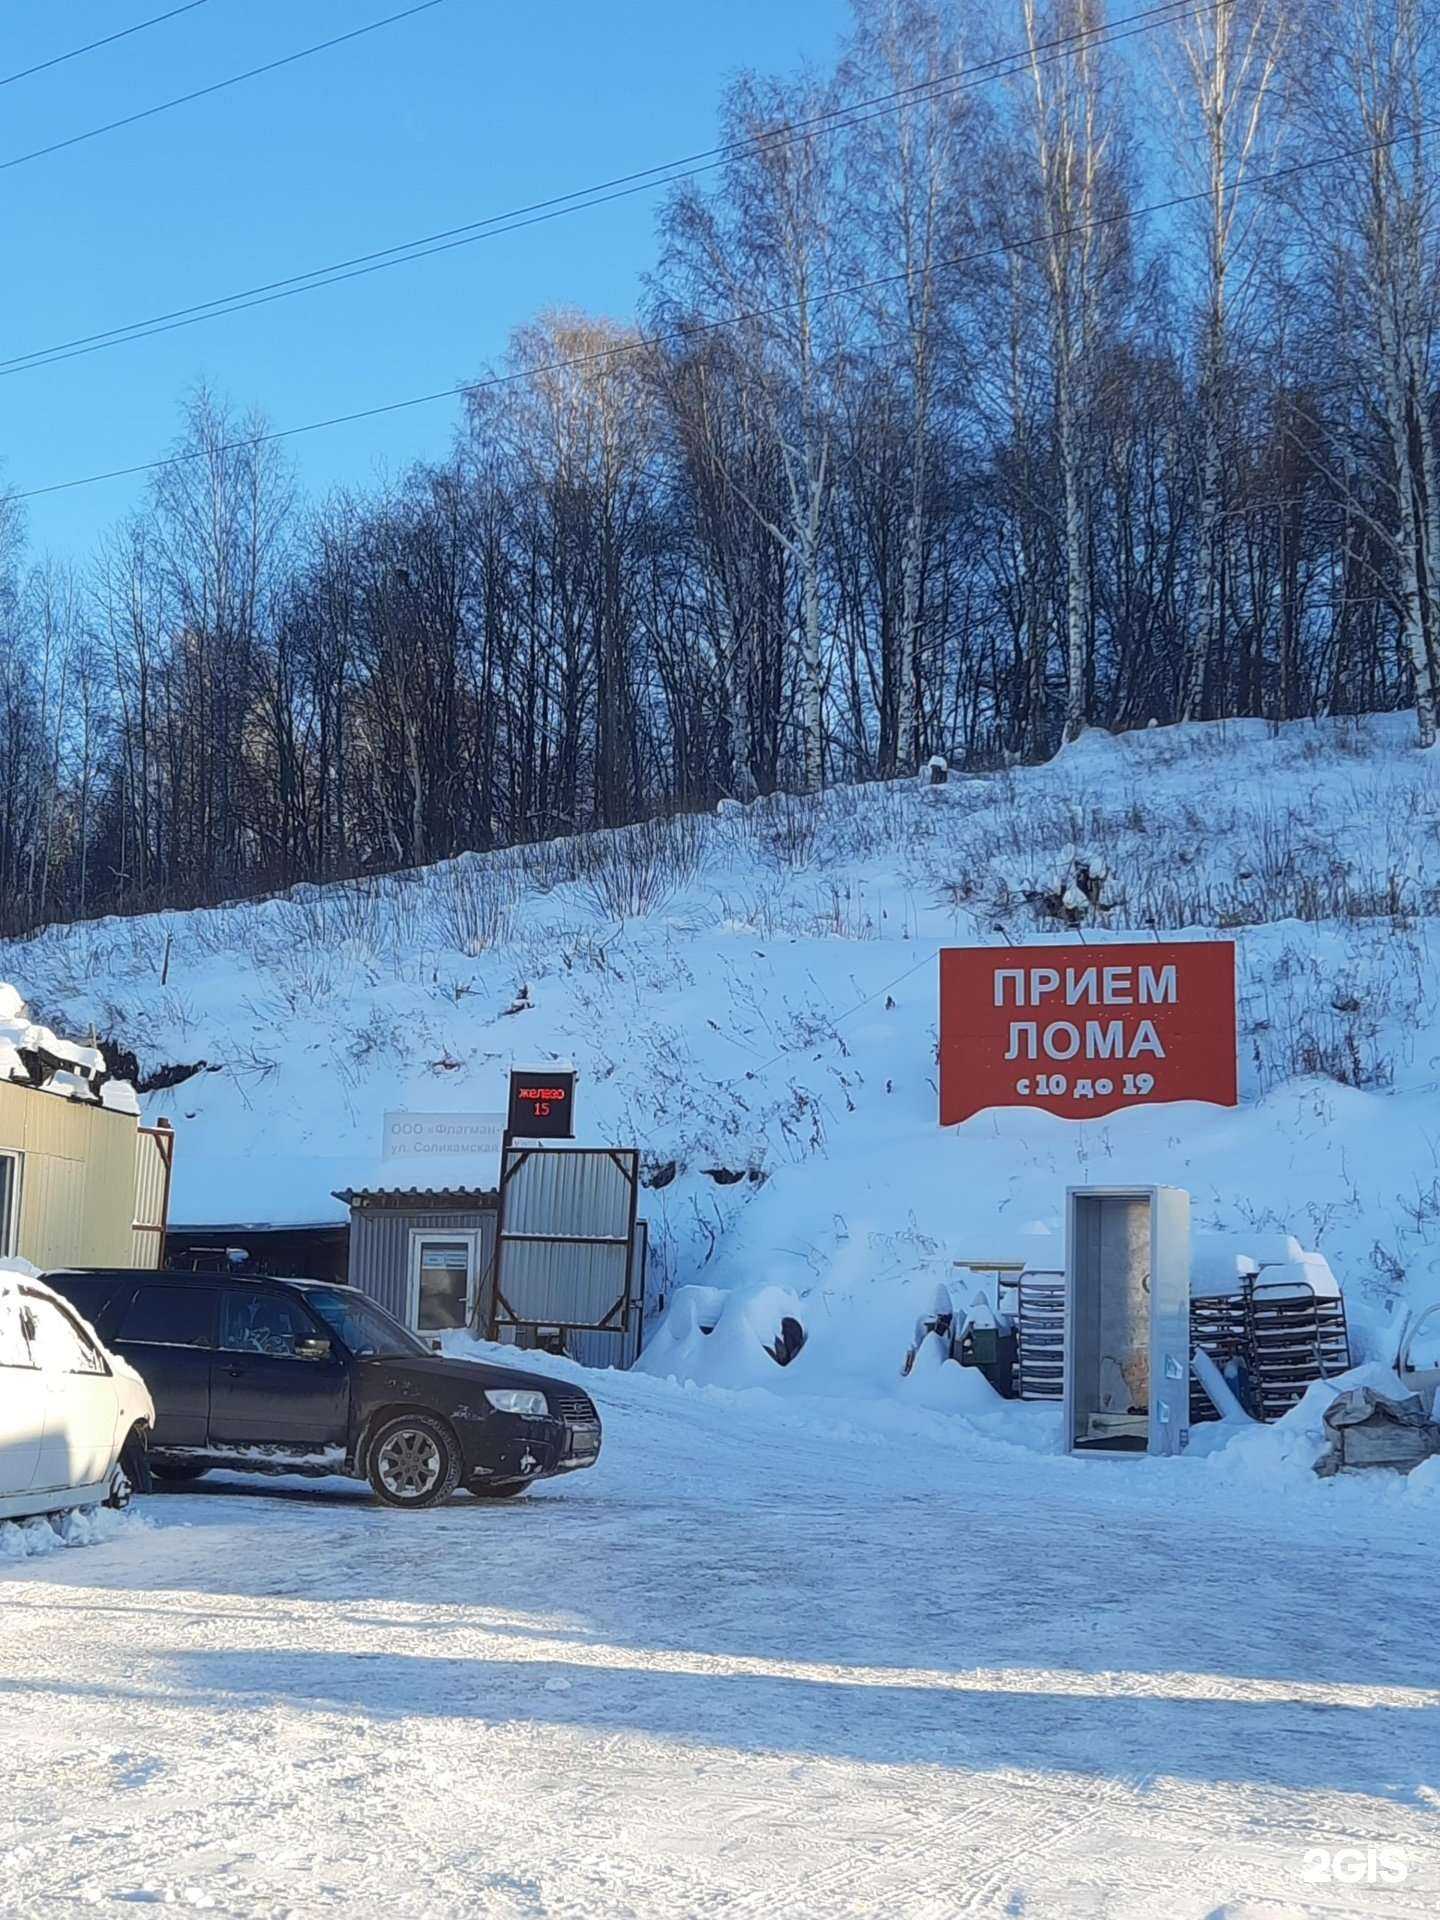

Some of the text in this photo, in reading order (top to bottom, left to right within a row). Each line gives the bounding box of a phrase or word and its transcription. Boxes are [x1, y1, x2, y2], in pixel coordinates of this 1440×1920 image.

[993, 964, 1177, 1007] ПРИЕМ
[1003, 1019, 1166, 1060] ЛОМА
[518, 1087, 566, 1100] железо
[1015, 1072, 1155, 1099] с 10 до 19
[534, 1103, 550, 1116] 15
[391, 1123, 424, 1136] ООО
